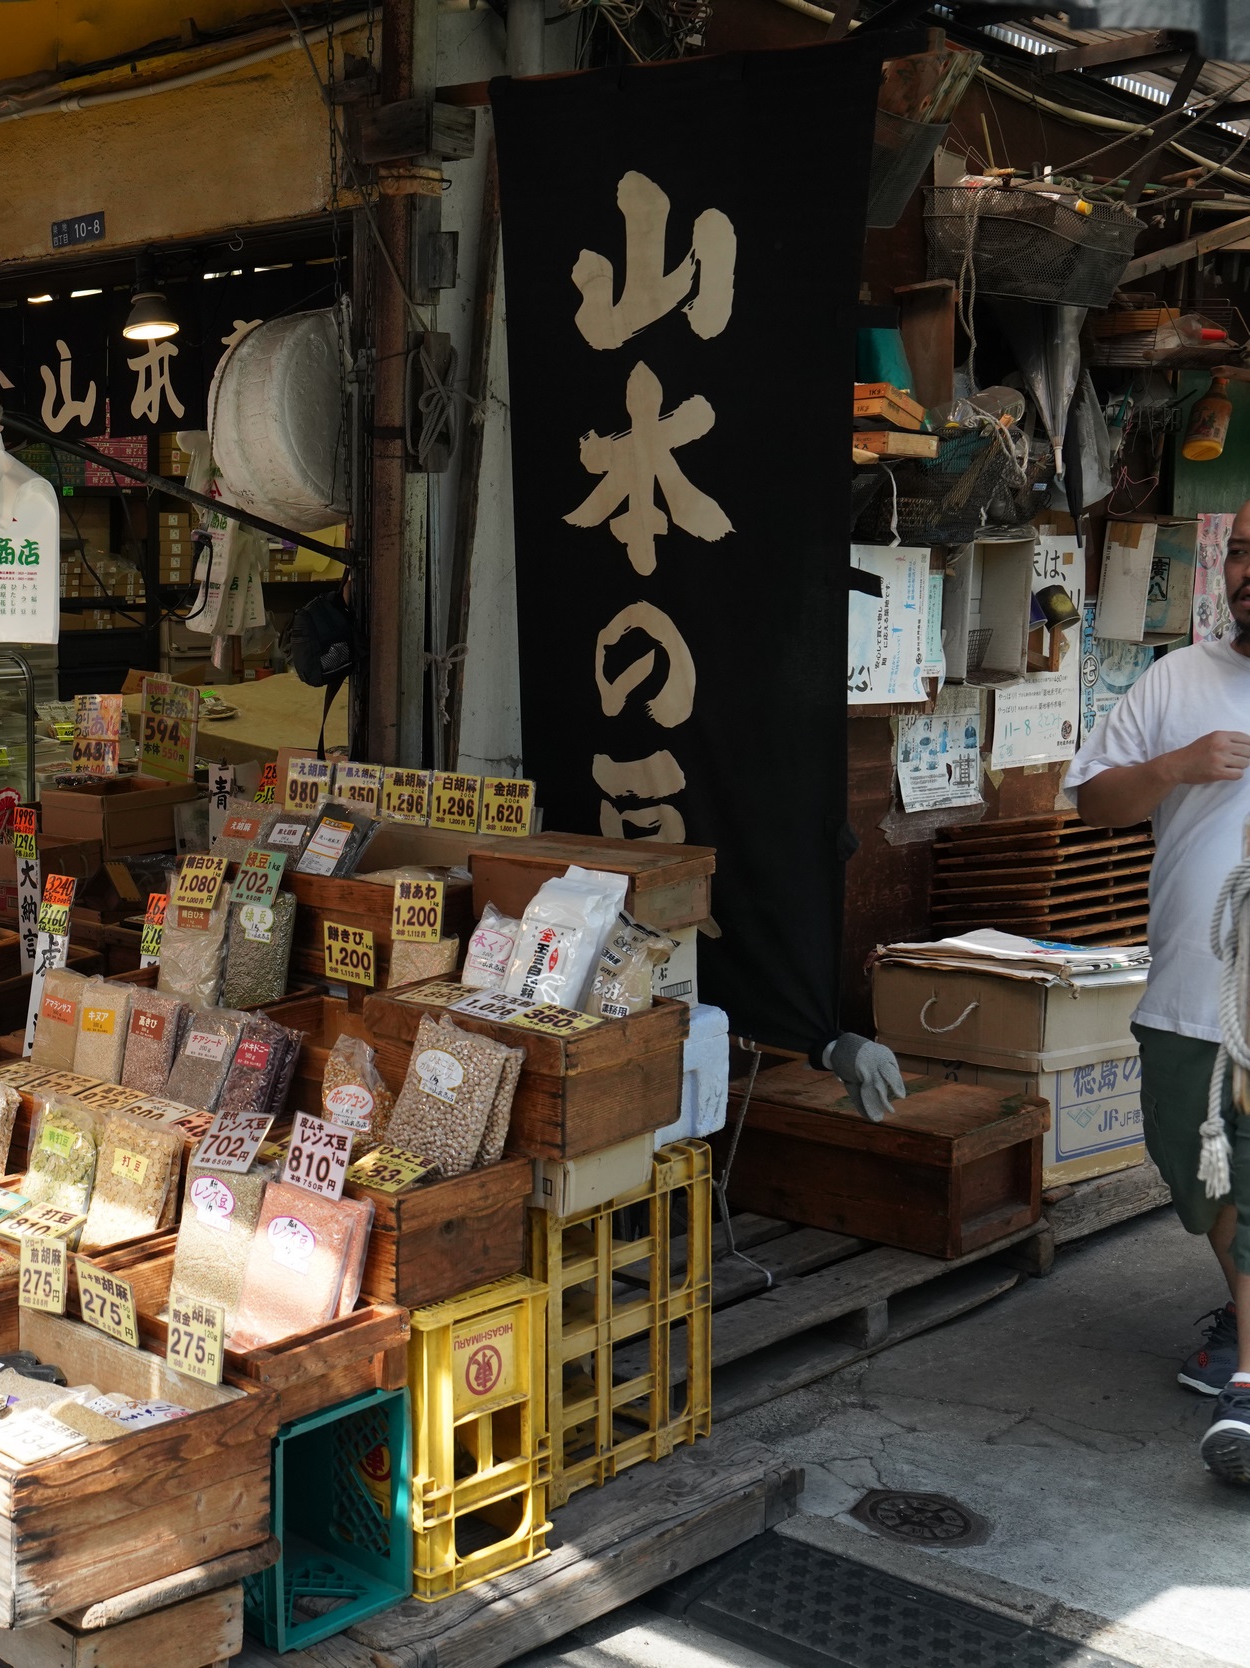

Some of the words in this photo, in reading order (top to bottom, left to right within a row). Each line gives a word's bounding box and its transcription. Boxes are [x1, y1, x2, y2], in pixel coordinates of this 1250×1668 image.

[74, 219, 101, 239] 10-8
[149, 694, 189, 718] そば粉
[297, 762, 329, 778] え胡麻
[345, 765, 378, 780] 黒え胡麻
[392, 771, 428, 789] 黒胡麻
[288, 778, 320, 804] 980
[442, 775, 478, 794] 白胡麻
[493, 781, 531, 800] 金胡麻
[385, 791, 425, 814] 1,296
[435, 795, 475, 819] 1,296
[483, 802, 524, 825] 1,620
[185, 855, 224, 872] 精白ひえ
[244, 850, 270, 870] 緑豆
[177, 873, 219, 894] 1,080
[399, 881, 438, 902] 餅あわ
[20, 859, 39, 960] 大納言
[181, 910, 205, 921] 精白ひえ
[393, 903, 438, 929] 1,200
[327, 924, 365, 947] 餅きび
[324, 945, 372, 973] 1,200
[44, 997, 73, 1014] アマランサス
[464, 998, 518, 1017] 1,026
[490, 993, 537, 1008] 白玉粉
[601, 1002, 628, 1016] 業務用
[87, 1011, 110, 1023] キヌア
[138, 1015, 159, 1029] 高きび
[191, 1033, 223, 1048] チアシード
[330, 1089, 371, 1111] ポップコーン
[217, 1117, 270, 1134] レンズ豆
[221, 1111, 241, 1121] 皮付
[299, 1117, 326, 1133] 皮ムキ
[203, 1134, 251, 1163] 702円
[300, 1129, 350, 1152] レンズ豆
[121, 1154, 142, 1173] 打豆
[288, 1145, 331, 1183] 810
[378, 1145, 437, 1169] ひよこ豆
[194, 1183, 229, 1211] レンズ豆
[37, 1206, 80, 1226] 打豆
[30, 1247, 62, 1267] 煎胡麻
[22, 1267, 53, 1298] 275
[81, 1287, 123, 1327] 275
[170, 1327, 207, 1364] 275
[453, 1322, 514, 1352] HIGASHIMARU
